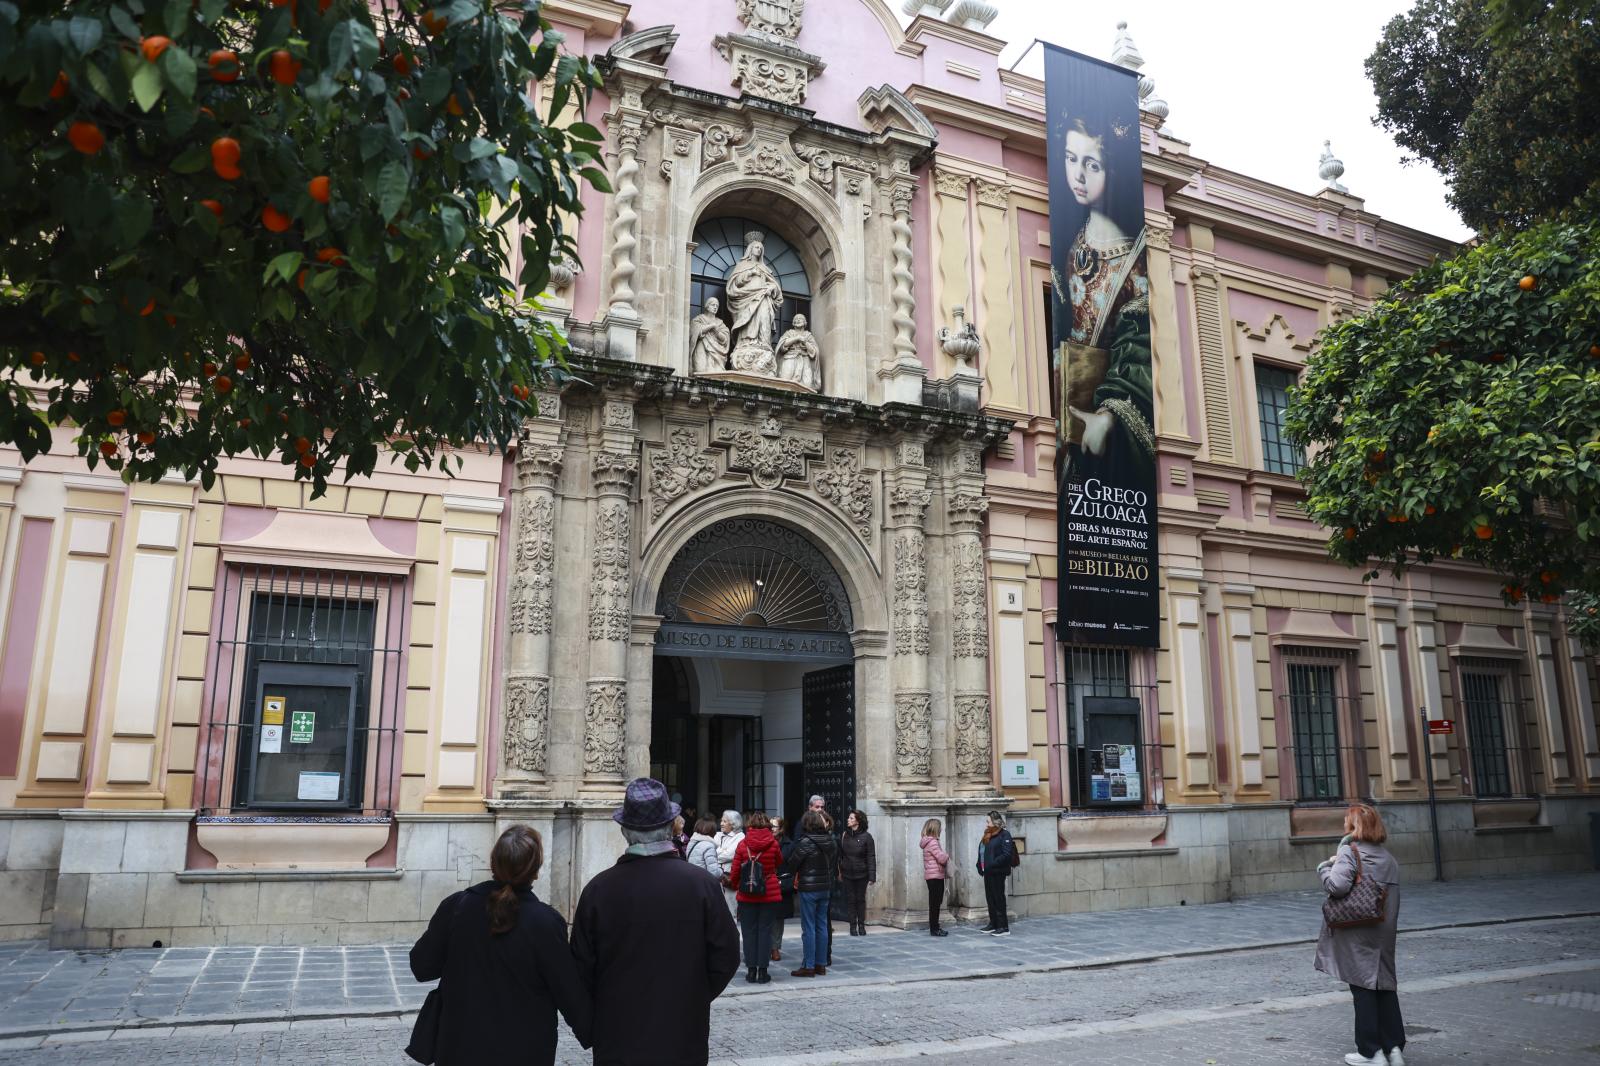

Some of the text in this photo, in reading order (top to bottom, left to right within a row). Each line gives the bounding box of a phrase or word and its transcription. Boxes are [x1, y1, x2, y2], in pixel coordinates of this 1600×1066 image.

[1068, 478, 1147, 507] DEL GRECO
[1068, 492, 1148, 524] ZULOAGA
[1068, 522, 1148, 539] OBRAS MAESTRAS
[1069, 534, 1148, 549] DEL ARTE ESPAÑOL
[1079, 550, 1102, 558] MUSEO
[1108, 553, 1130, 562] BELLAS
[1130, 555, 1148, 564] ARTES
[1069, 559, 1149, 581] DE BILBAO
[655, 630, 845, 654] MUSEO DE BELLAS ARTES
